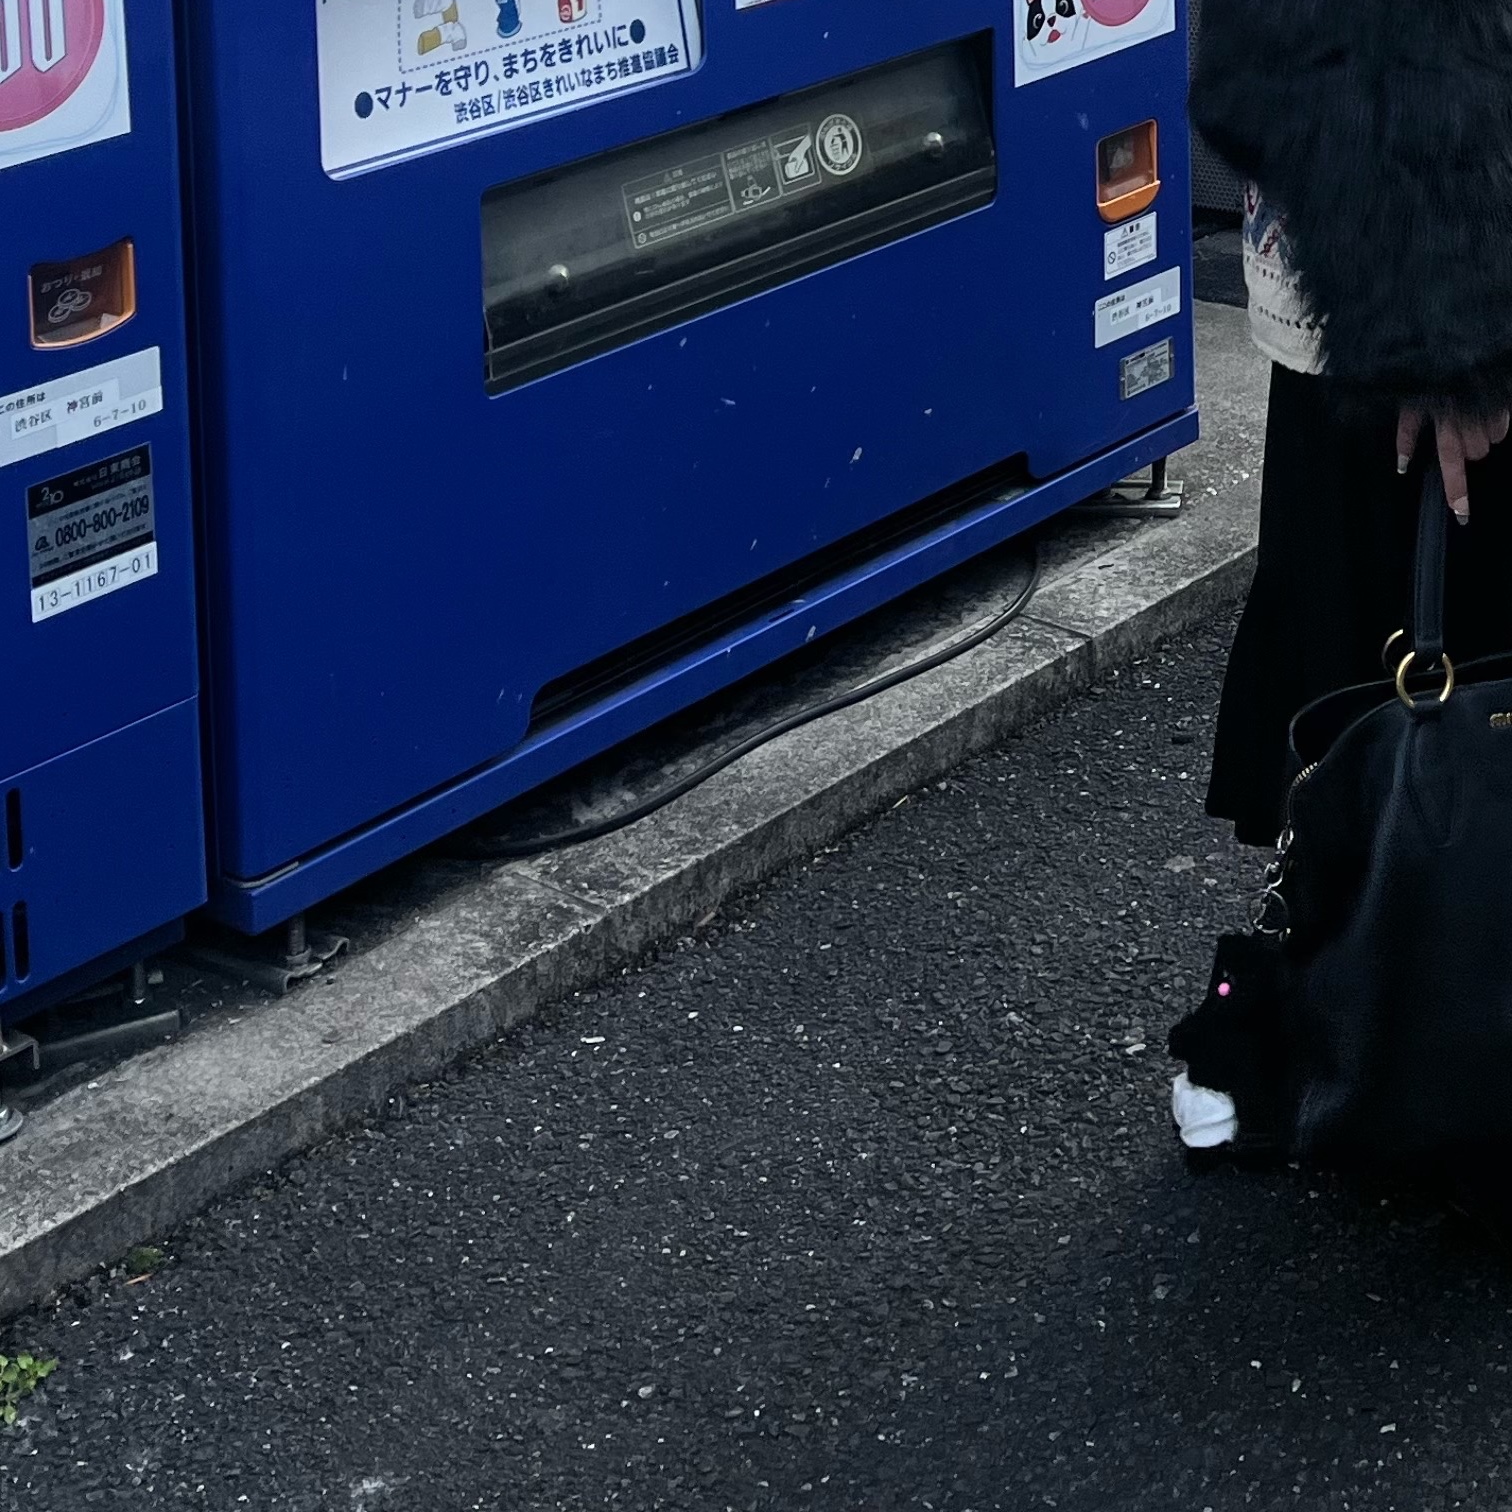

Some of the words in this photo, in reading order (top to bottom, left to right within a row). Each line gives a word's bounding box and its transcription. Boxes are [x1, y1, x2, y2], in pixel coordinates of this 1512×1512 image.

[15, 409, 52, 432] 渋谷区
[67, 390, 103, 414] 神宮前
[93, 399, 147, 428] 6-7-10
[55, 494, 149, 547] 0800-800-2109
[39, 554, 150, 611] 13-1167-01
